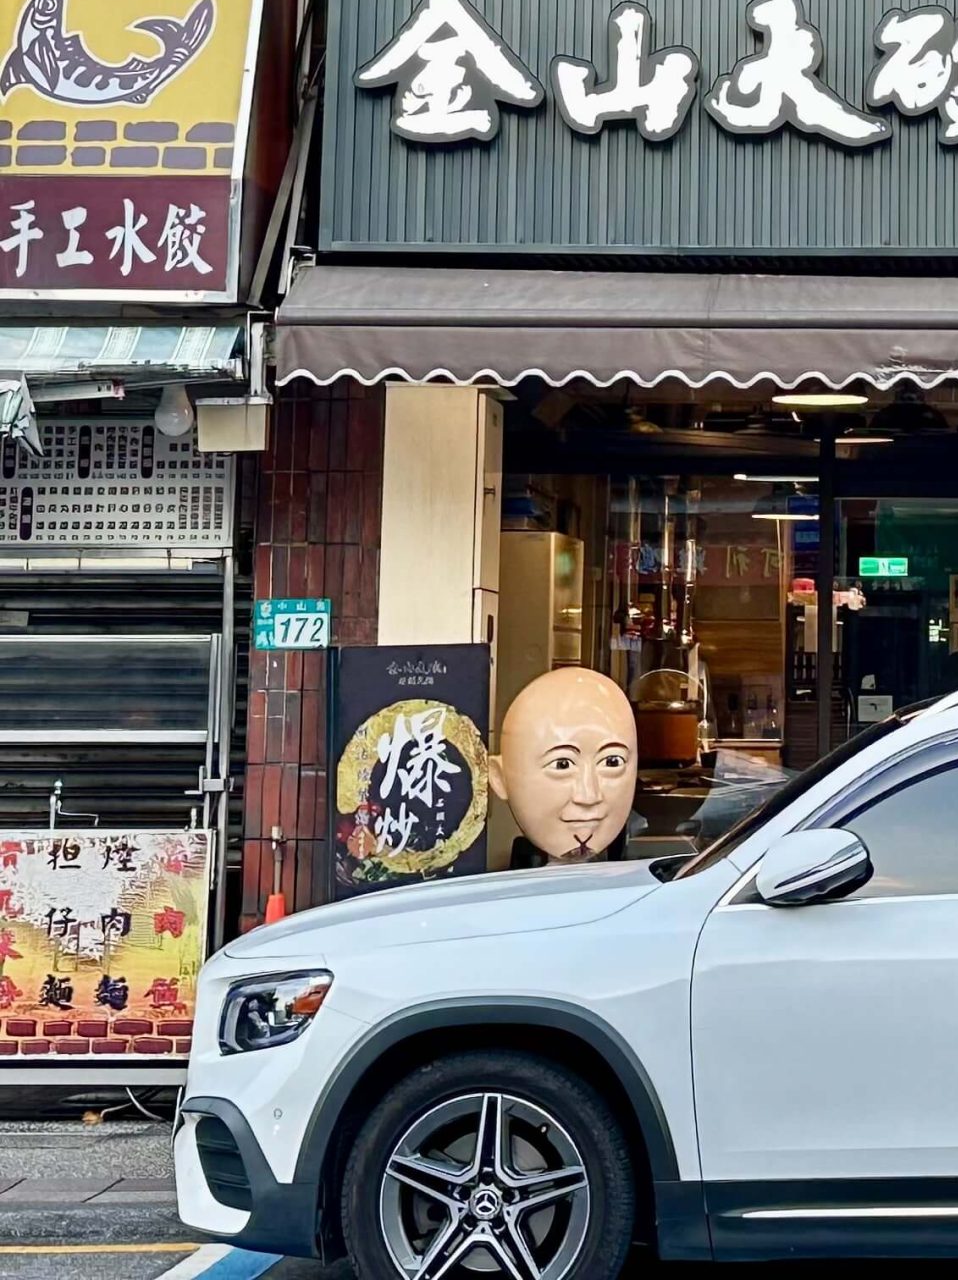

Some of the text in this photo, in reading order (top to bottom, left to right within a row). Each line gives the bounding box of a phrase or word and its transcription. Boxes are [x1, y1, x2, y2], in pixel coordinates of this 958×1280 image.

[1, 198, 213, 277] 手工水餃
[280, 617, 324, 643] 172
[375, 708, 461, 858] 爆炒
